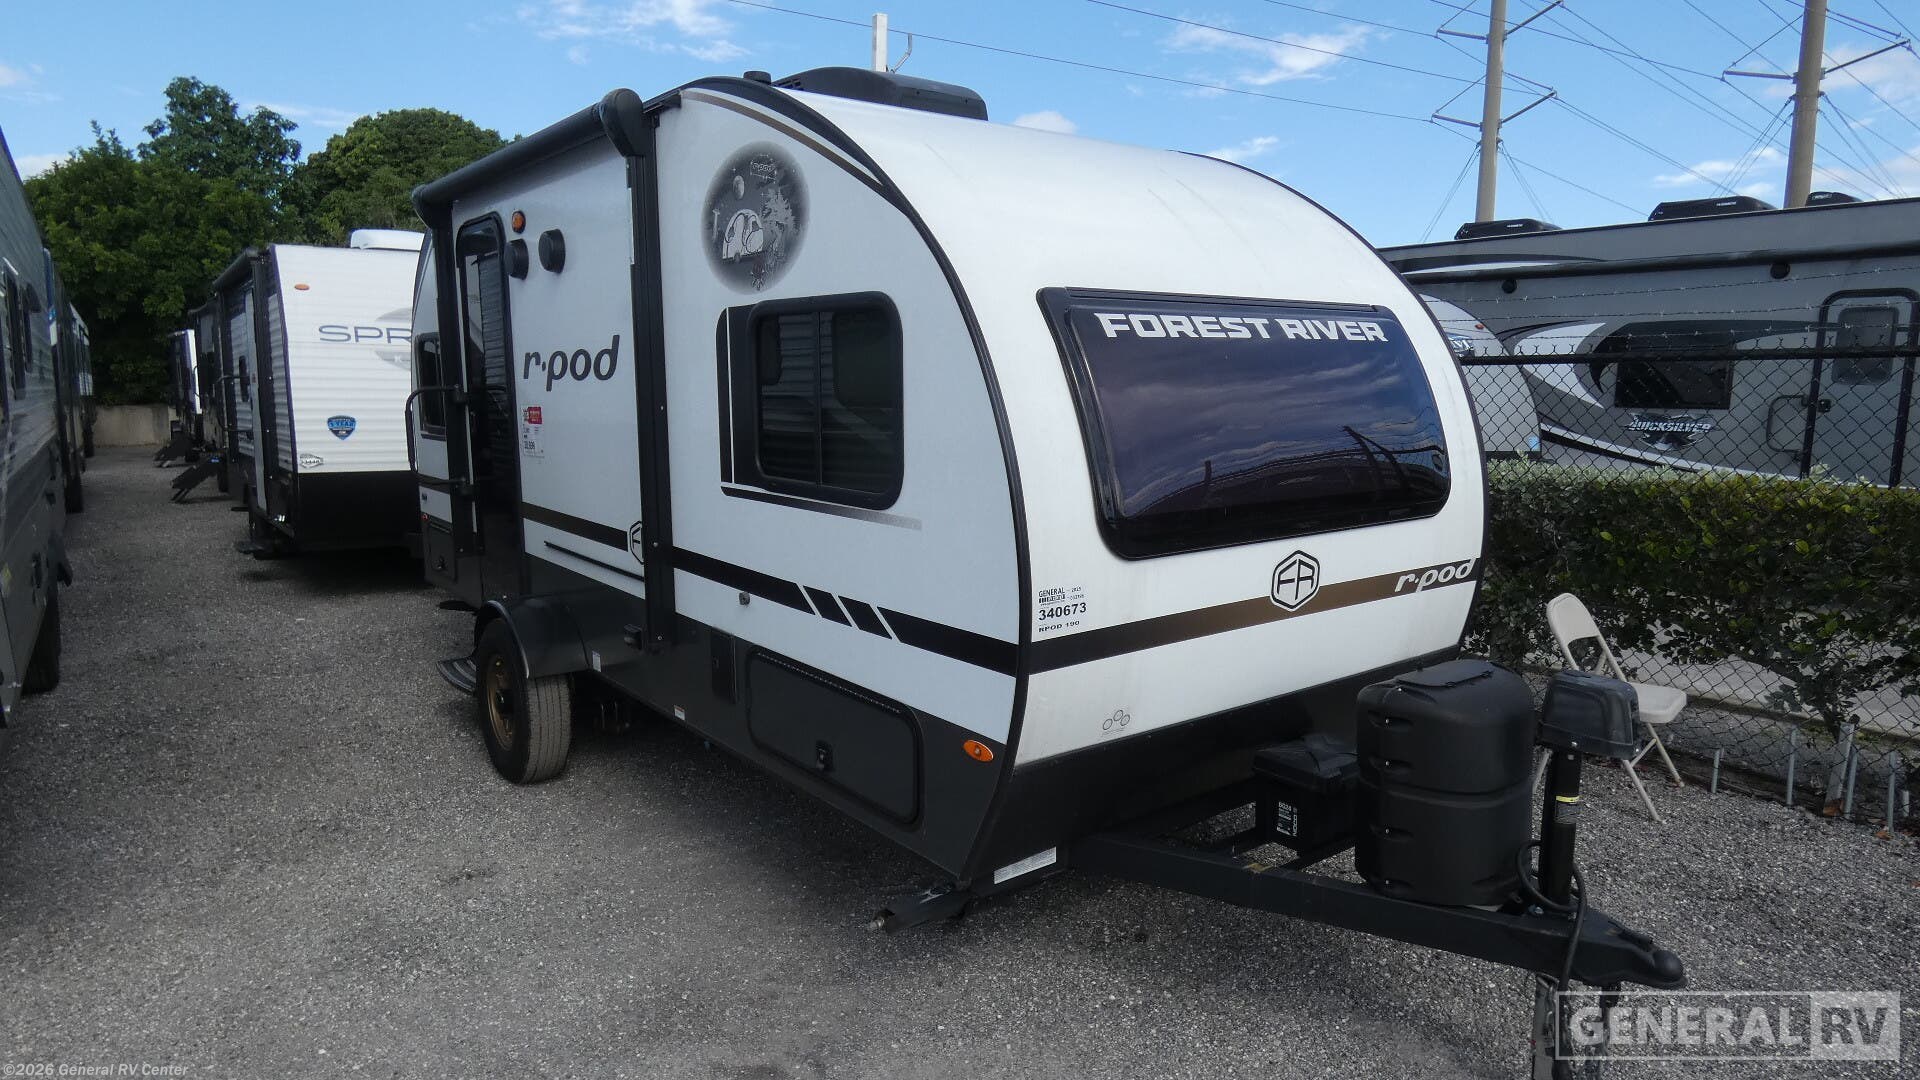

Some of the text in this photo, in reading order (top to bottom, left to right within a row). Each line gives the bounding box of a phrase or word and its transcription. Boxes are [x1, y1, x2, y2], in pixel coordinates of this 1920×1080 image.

[1094, 312, 1389, 343] FOREST RIVER
[1038, 587, 1065, 598] GENERAL
[1038, 602, 1087, 621] 340673
